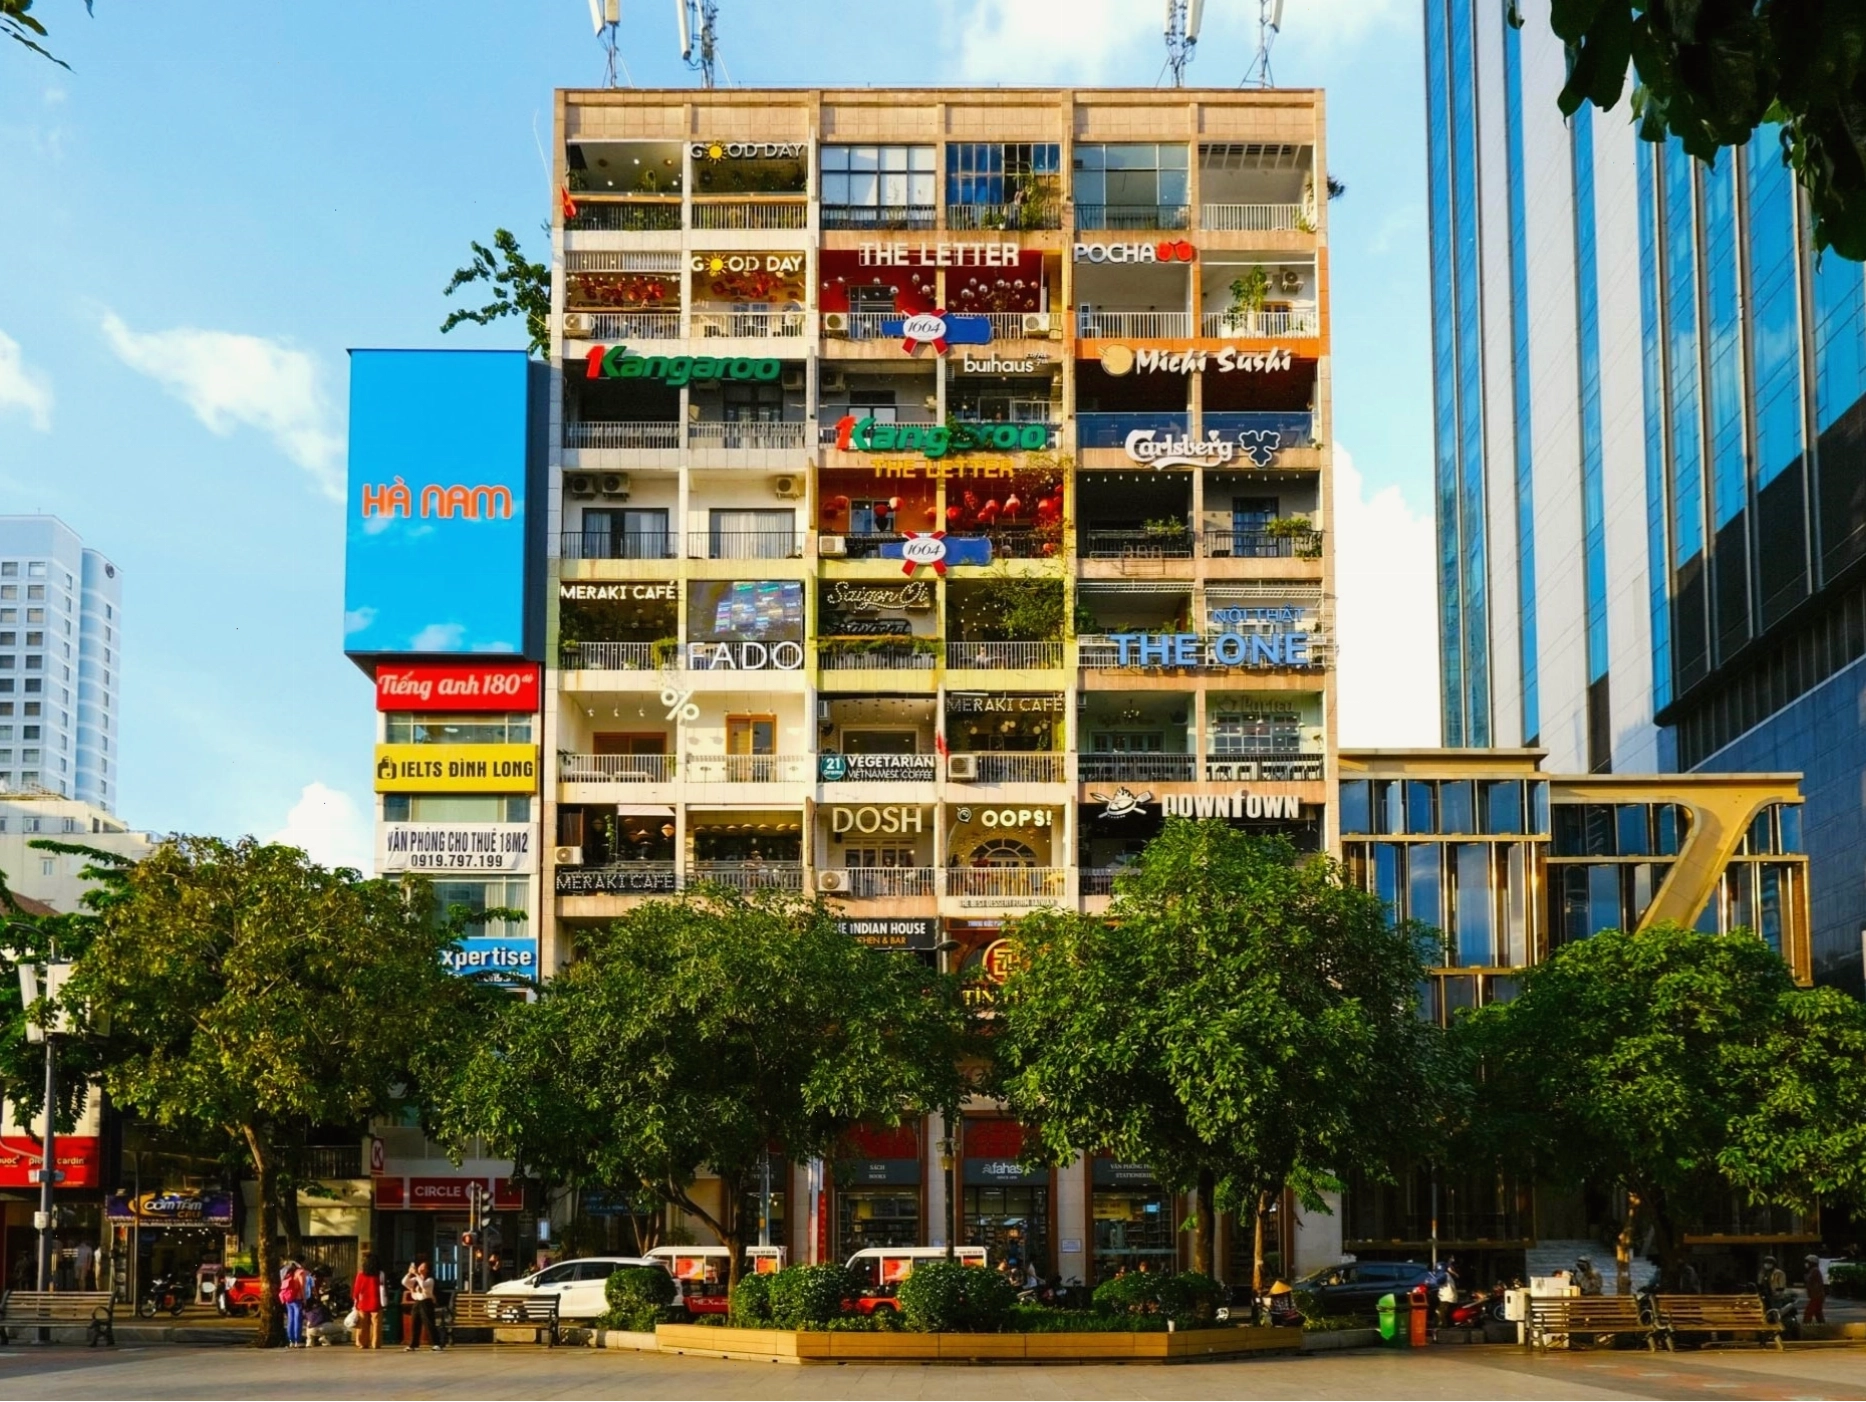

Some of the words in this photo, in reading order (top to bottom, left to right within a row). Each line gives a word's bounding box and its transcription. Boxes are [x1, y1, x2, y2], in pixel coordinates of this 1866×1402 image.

[764, 143, 803, 158] DAY
[859, 243, 909, 266] THE
[920, 242, 1019, 266] LETTER
[1074, 243, 1156, 263] POCHA
[767, 255, 802, 272] DAY
[907, 322, 942, 333] 1664
[1136, 347, 1206, 375] Michi
[1217, 346, 1291, 375] Sushi
[1125, 429, 1233, 468] Carlsberg
[871, 458, 916, 478] THE
[926, 458, 1014, 478] LETTER
[362, 475, 412, 518] HÀ
[420, 484, 512, 519] NAM
[906, 543, 940, 556] 1664
[560, 585, 626, 600] MERAKI
[633, 581, 676, 600] CAFÉ
[688, 641, 803, 670] FADO
[1110, 633, 1198, 666] THE
[1215, 632, 1308, 666] ONE
[378, 671, 433, 701] Tiếng
[437, 674, 479, 695] anh
[482, 674, 520, 695] 180
[947, 697, 1013, 712] MERAKI
[1019, 694, 1064, 712] CAFÉ
[401, 761, 442, 777] IELTS
[448, 758, 487, 777] ĐÌNH
[493, 761, 533, 777] LONG
[826, 757, 841, 770] 21
[847, 755, 934, 768] VEGETARIAN
[848, 768, 899, 779] VIETNAMESE
[901, 768, 933, 779] COFFEE
[832, 806, 922, 833] DOSH
[981, 810, 1052, 827] OOPS!
[387, 827, 408, 852] VĂN
[448, 831, 468, 852] CHO
[500, 832, 528, 853] 18M2
[411, 854, 503, 867] 0919.797.199
[556, 874, 625, 889] MERAKI
[631, 871, 674, 889] CAFÉ
[850, 923, 887, 934] INDIAN
[891, 923, 926, 934] HOUSE
[440, 947, 532, 970] xpertise
[57, 1157, 84, 1165] cardin
[415, 1186, 461, 1197] CIRCLE
